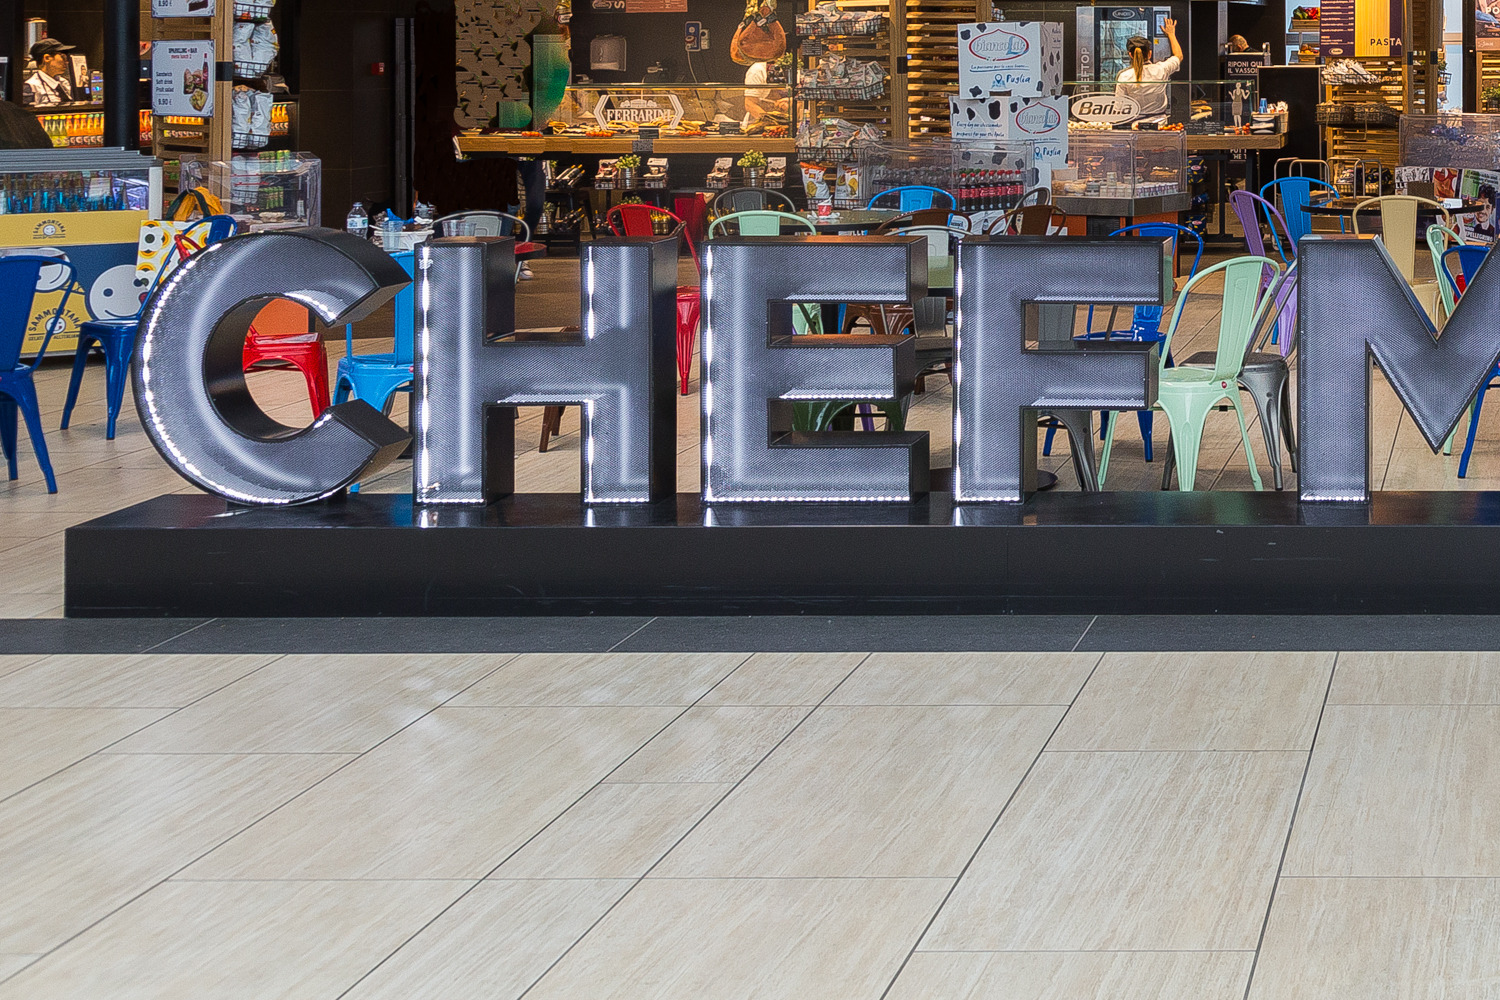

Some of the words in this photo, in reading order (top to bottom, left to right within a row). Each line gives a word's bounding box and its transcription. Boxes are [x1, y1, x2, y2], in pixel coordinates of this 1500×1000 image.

[1370, 37, 1402, 46] PASTA
[1006, 73, 1030, 84] Puglia
[1078, 100, 1132, 115] Baria
[606, 108, 672, 122] FERRARINI
[132, 228, 1173, 507] CHEF
